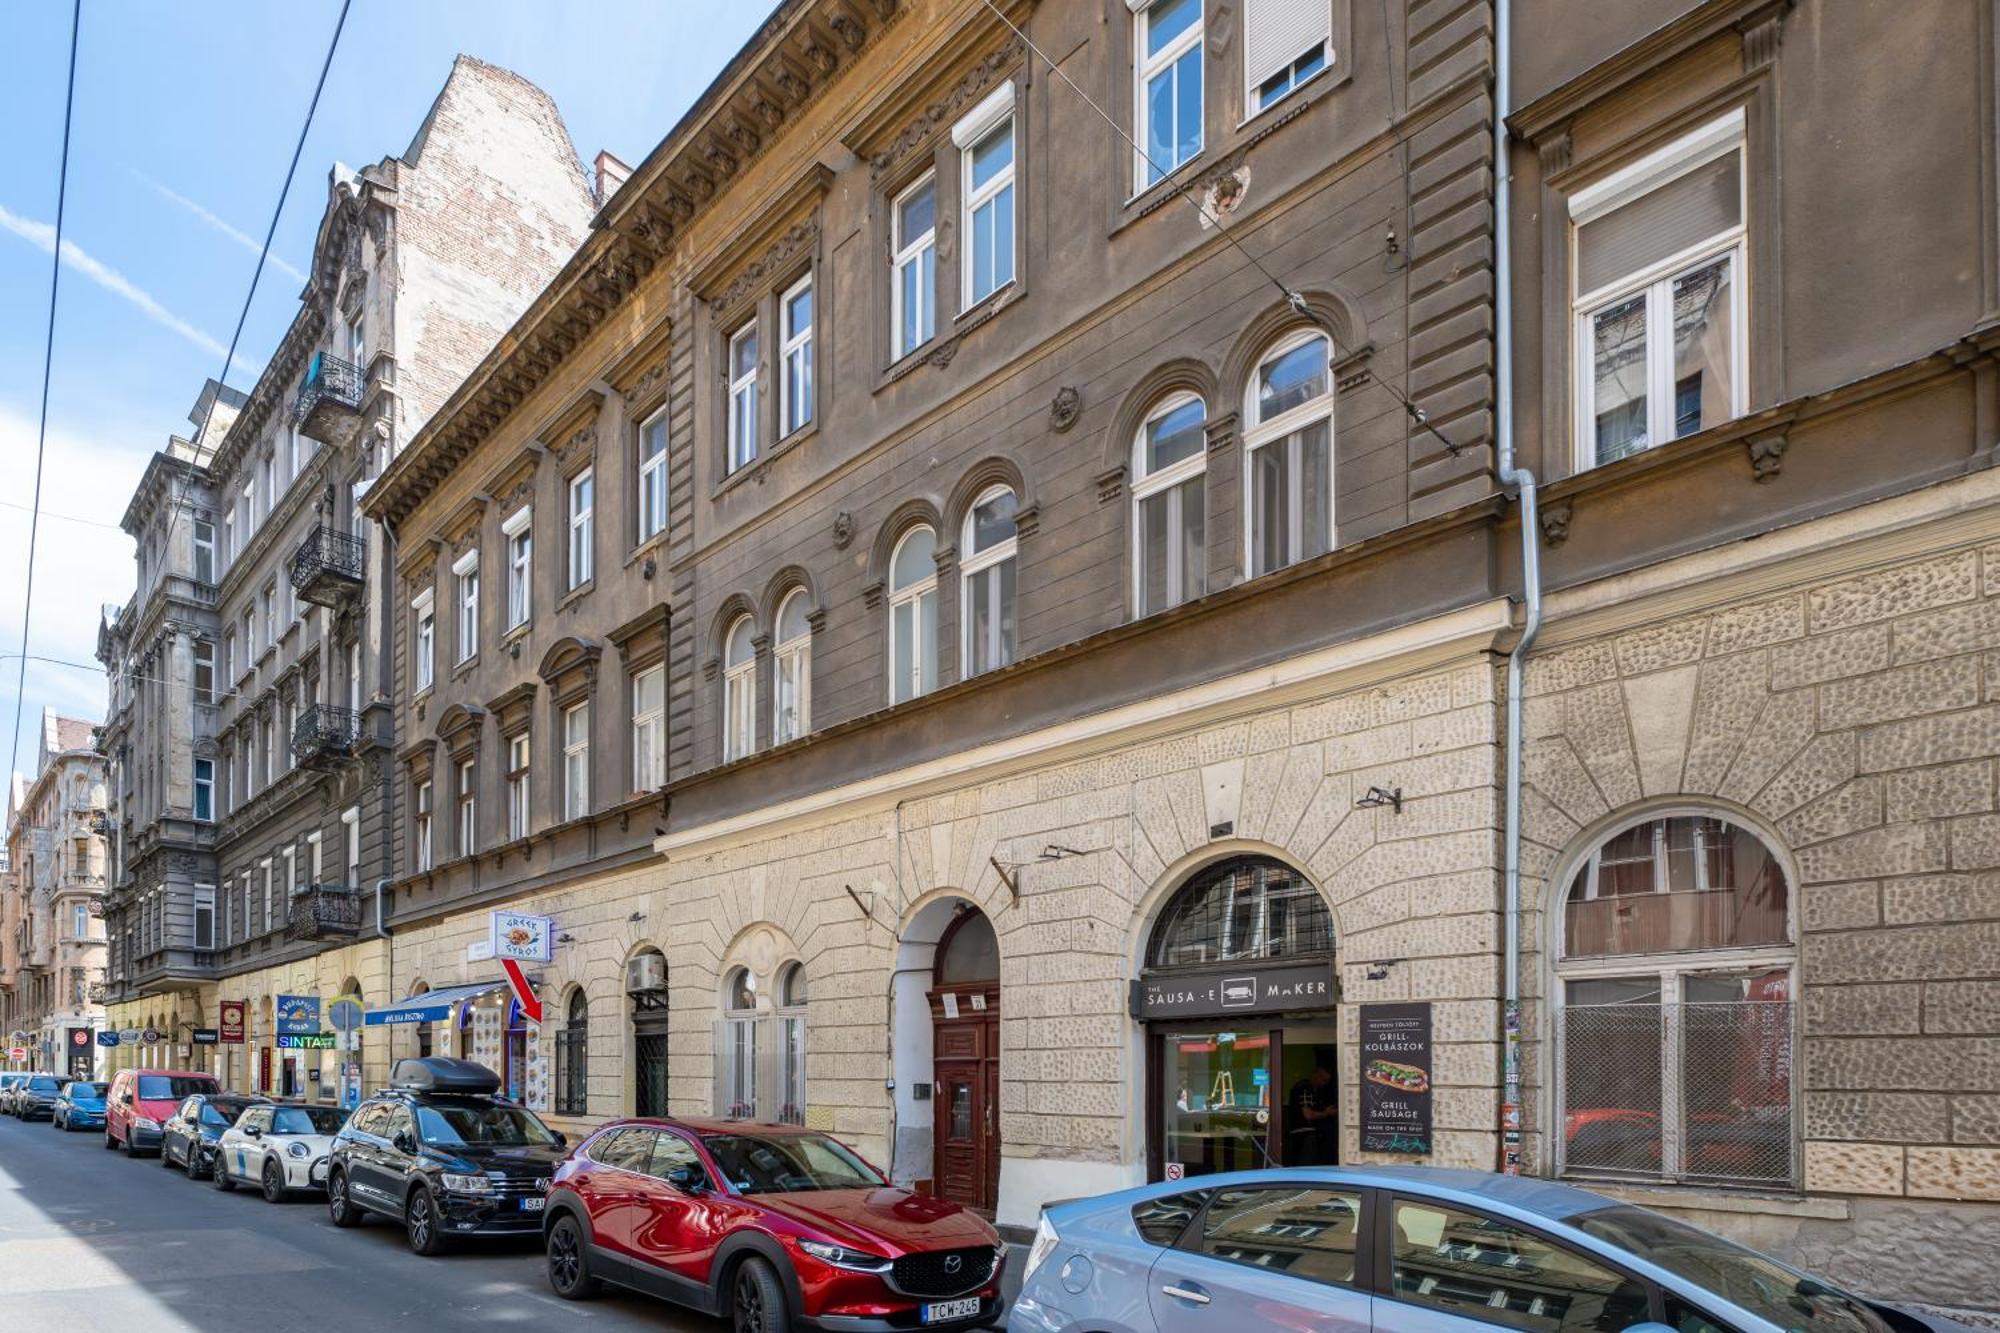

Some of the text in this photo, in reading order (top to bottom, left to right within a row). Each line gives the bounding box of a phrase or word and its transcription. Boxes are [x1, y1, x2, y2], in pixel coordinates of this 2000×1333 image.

[506, 918, 537, 931] GREEK
[506, 944, 538, 957] GYROS
[1148, 989, 1216, 1005] SAUSAE
[1365, 1041, 1424, 1051] KOLBÁSZOK
[1381, 1101, 1408, 1110] GRILL
[1370, 1110, 1418, 1119] SAUSAGE
